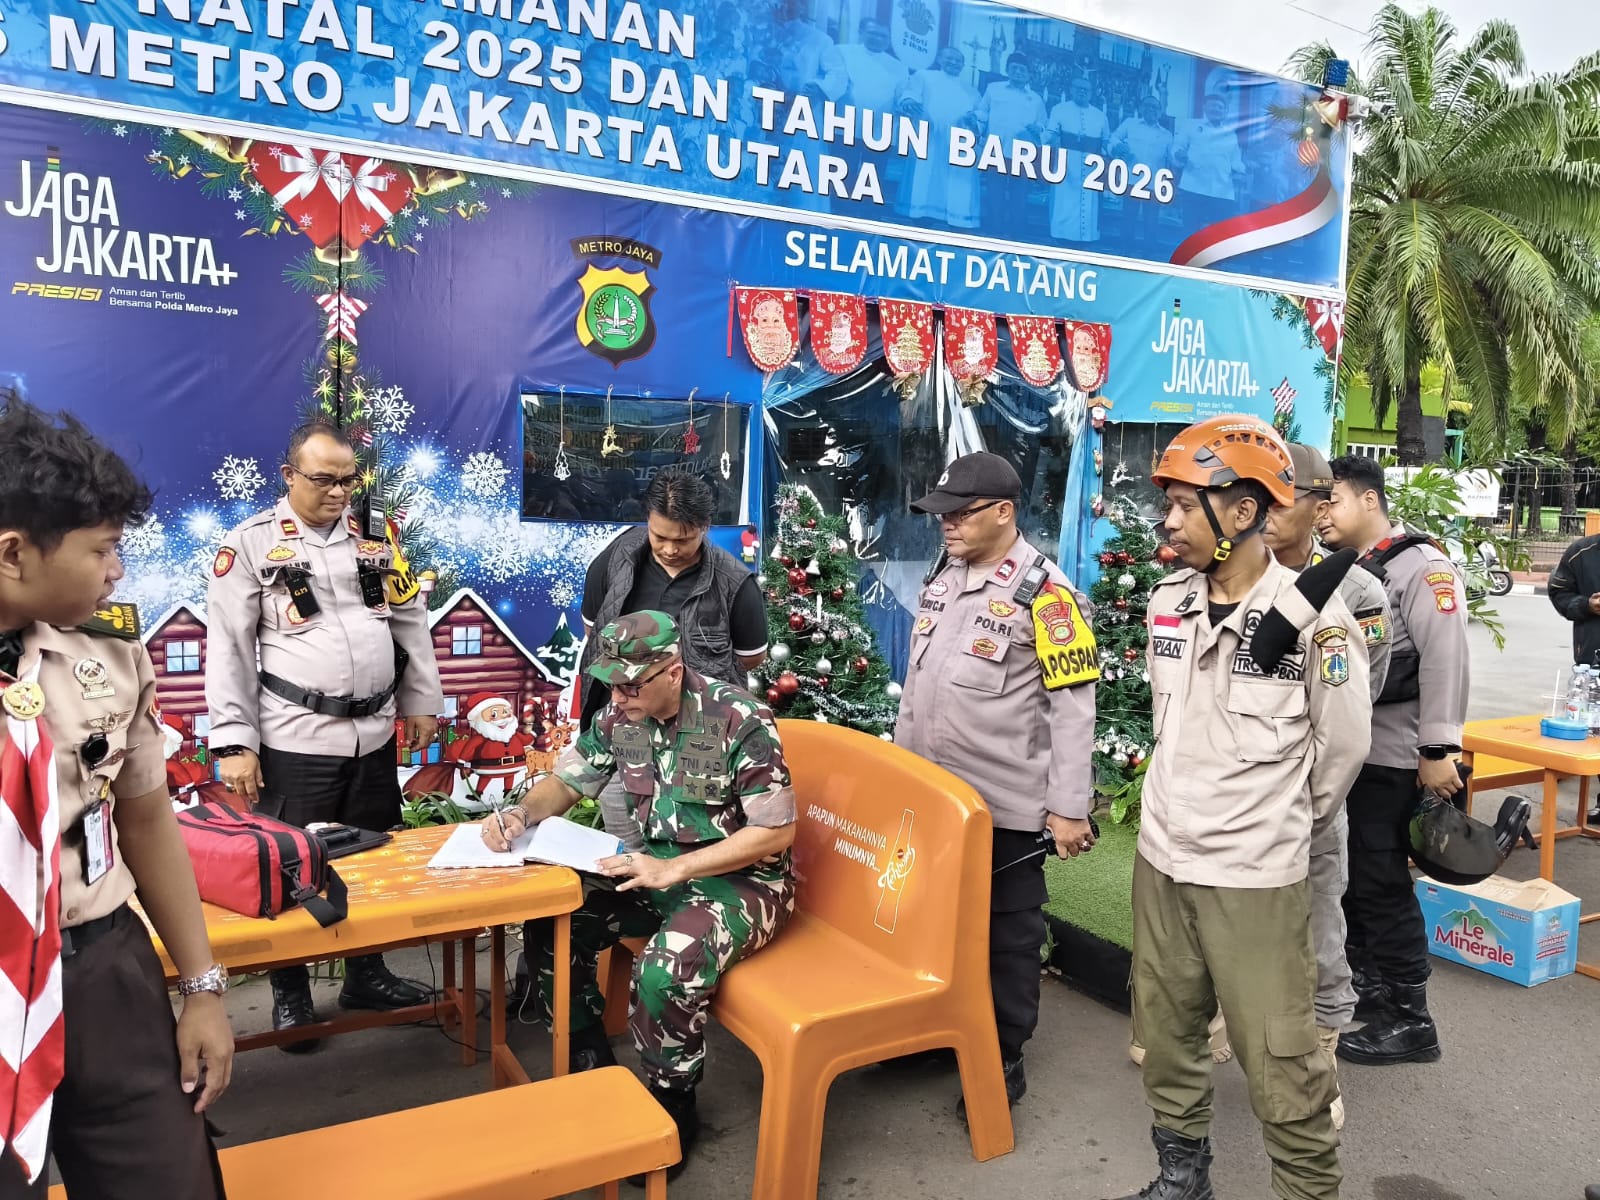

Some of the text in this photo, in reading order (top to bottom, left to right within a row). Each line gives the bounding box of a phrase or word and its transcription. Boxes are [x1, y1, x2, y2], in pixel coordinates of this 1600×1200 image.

[49, 14, 343, 112] METRO
[373, 76, 683, 171] JAKARTA
[706, 133, 884, 204] UTARA
[423, 20, 583, 93] 2025
[610, 57, 729, 123] DAN
[752, 86, 929, 160] TAHUN
[949, 125, 1068, 184] BARU
[1084, 154, 1174, 204] 2026
[5, 160, 119, 227] JAGA
[579, 241, 654, 263] METRO JAYA
[784, 230, 1097, 302] SELAMAT DATANG
[11, 282, 186, 301] PRESISI Aman dan Tertib
[109, 297, 238, 316] Bersama Polda Metro Jaya
[1151, 310, 1206, 357] JAGA
[974, 615, 1012, 637] POLRI
[1268, 663, 1297, 681] PBD
[614, 748, 647, 761] DANNY
[680, 757, 723, 772] TNI AD
[807, 803, 887, 851] APAPUN MAKANANNYA
[1462, 916, 1485, 940] Le
[1434, 925, 1515, 967] Minerale
